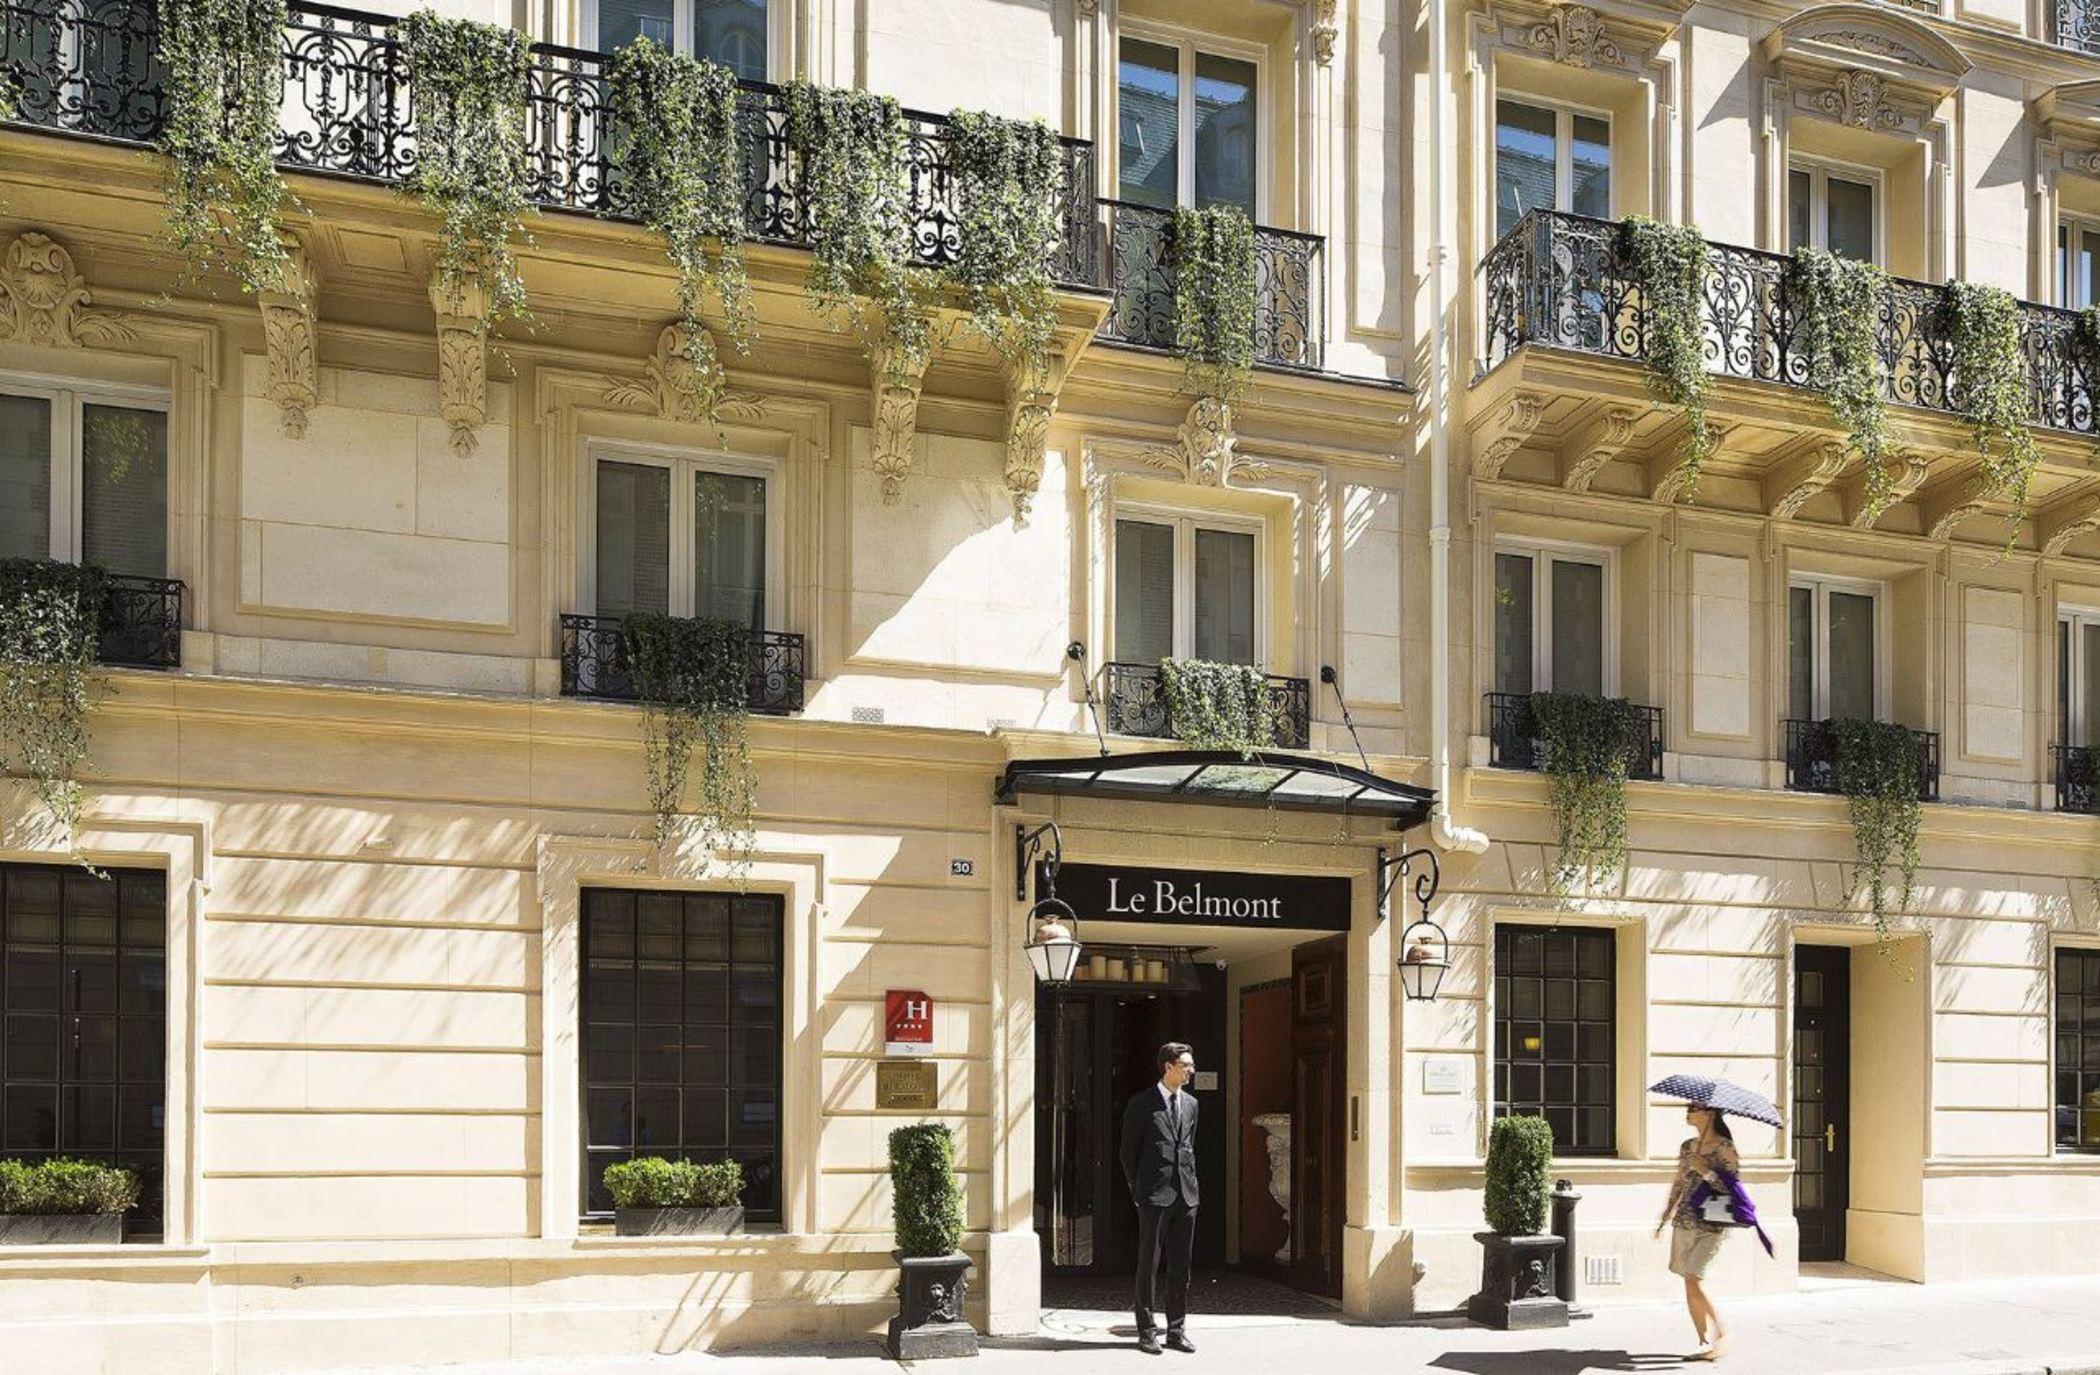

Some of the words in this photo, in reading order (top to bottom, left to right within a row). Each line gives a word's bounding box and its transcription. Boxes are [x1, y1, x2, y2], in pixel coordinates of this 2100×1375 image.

[953, 861, 970, 873] 30
[1106, 877, 1146, 914] Le
[1152, 879, 1282, 919] Belmont
[907, 1000, 928, 1020] H
